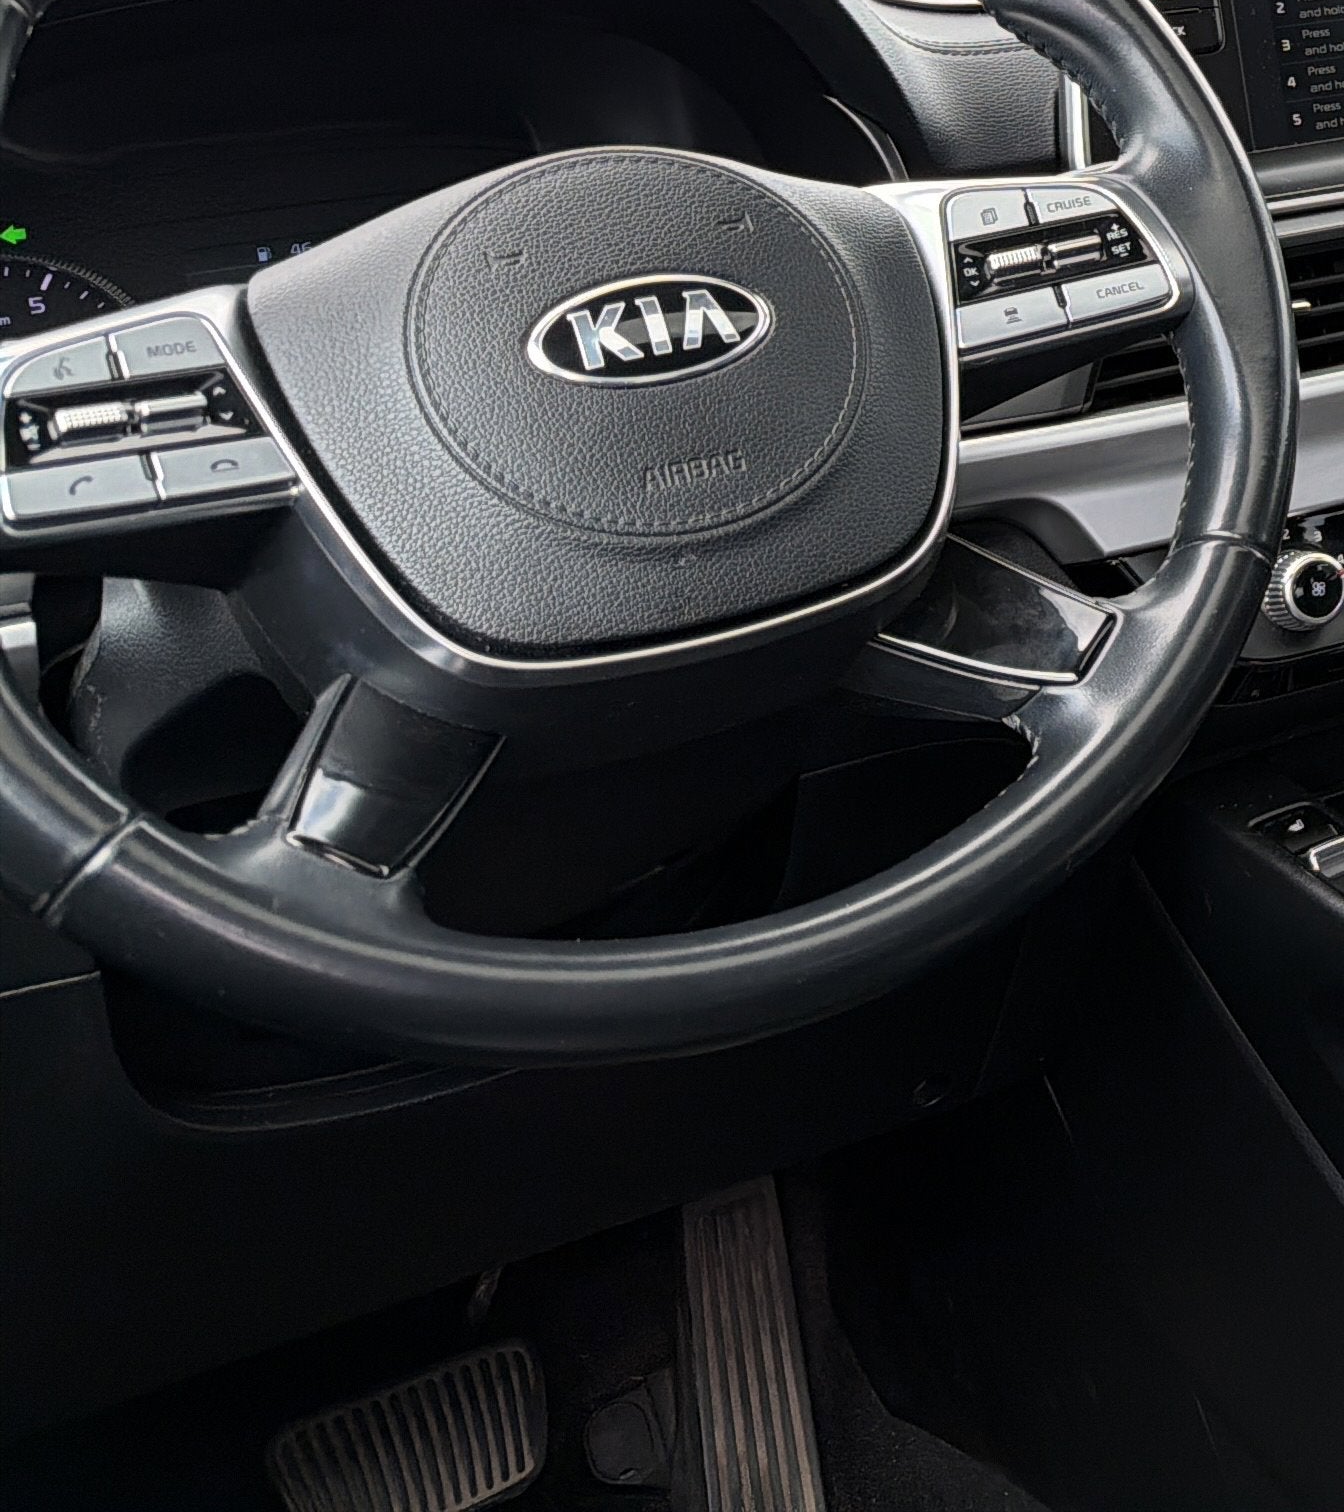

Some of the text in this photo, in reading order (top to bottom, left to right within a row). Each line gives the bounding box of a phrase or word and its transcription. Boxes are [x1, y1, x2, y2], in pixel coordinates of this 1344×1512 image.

[1276, 2, 1286, 14] 2
[1299, 6, 1323, 19] and
[1301, 27, 1331, 40] Press
[1281, 39, 1291, 52] 3
[1304, 44, 1328, 57] and
[1307, 64, 1336, 76] Press
[1287, 76, 1297, 88] 4
[1310, 81, 1333, 94] and
[1312, 101, 1342, 113] Press
[1292, 114, 1302, 127] 5
[1315, 118, 1339, 131] and
[1046, 195, 1092, 214] CRUISE
[1106, 228, 1129, 241] RES
[1111, 241, 1132, 255] SET
[963, 266, 979, 278] OK
[1096, 281, 1145, 300] CANCEL
[28, 297, 46, 315] 5
[566, 289, 741, 371] KIA
[146, 340, 197, 357] MODE
[643, 449, 748, 489] AIRBAG
[1282, 528, 1291, 541] 2
[1313, 530, 1323, 543] 3
[1337, 553, 1344, 565] 4
